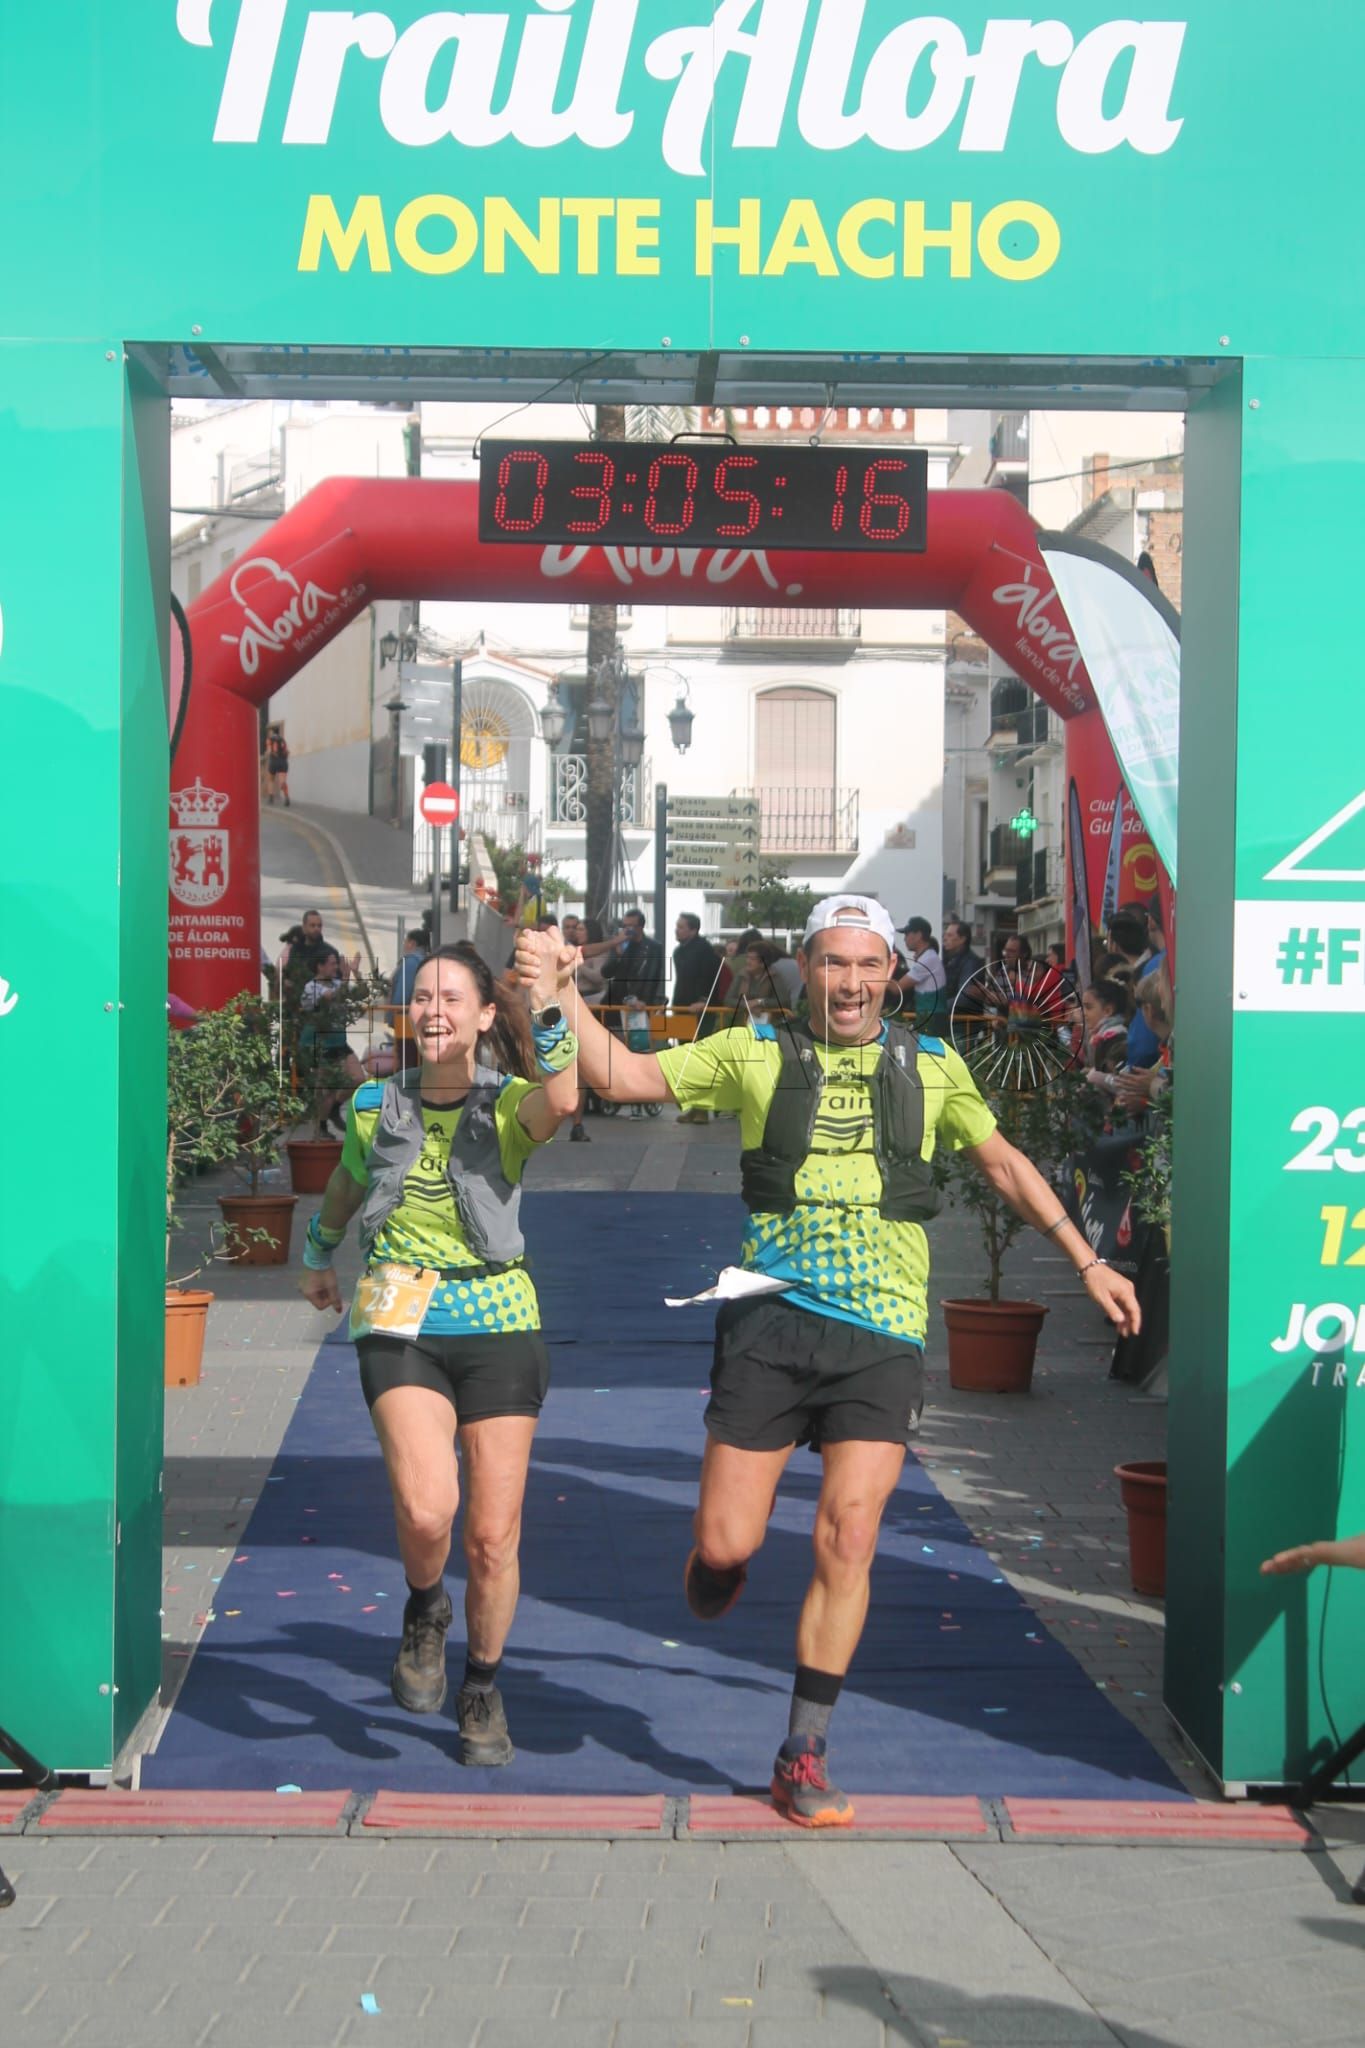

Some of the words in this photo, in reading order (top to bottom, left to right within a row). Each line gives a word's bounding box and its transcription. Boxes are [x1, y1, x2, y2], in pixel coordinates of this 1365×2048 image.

[297, 194, 660, 275] MONTE
[695, 197, 1061, 281] HACHO
[1015, 636, 1044, 670] llena
[1043, 667, 1061, 688] de
[1059, 681, 1086, 711] vida
[169, 931, 184, 942] DE
[187, 929, 229, 943] ÁLORA
[175, 948, 192, 959] DE
[195, 948, 251, 960] DEPORTES
[1276, 927, 1365, 985] #F
[1270, 1303, 1365, 1353] JO
